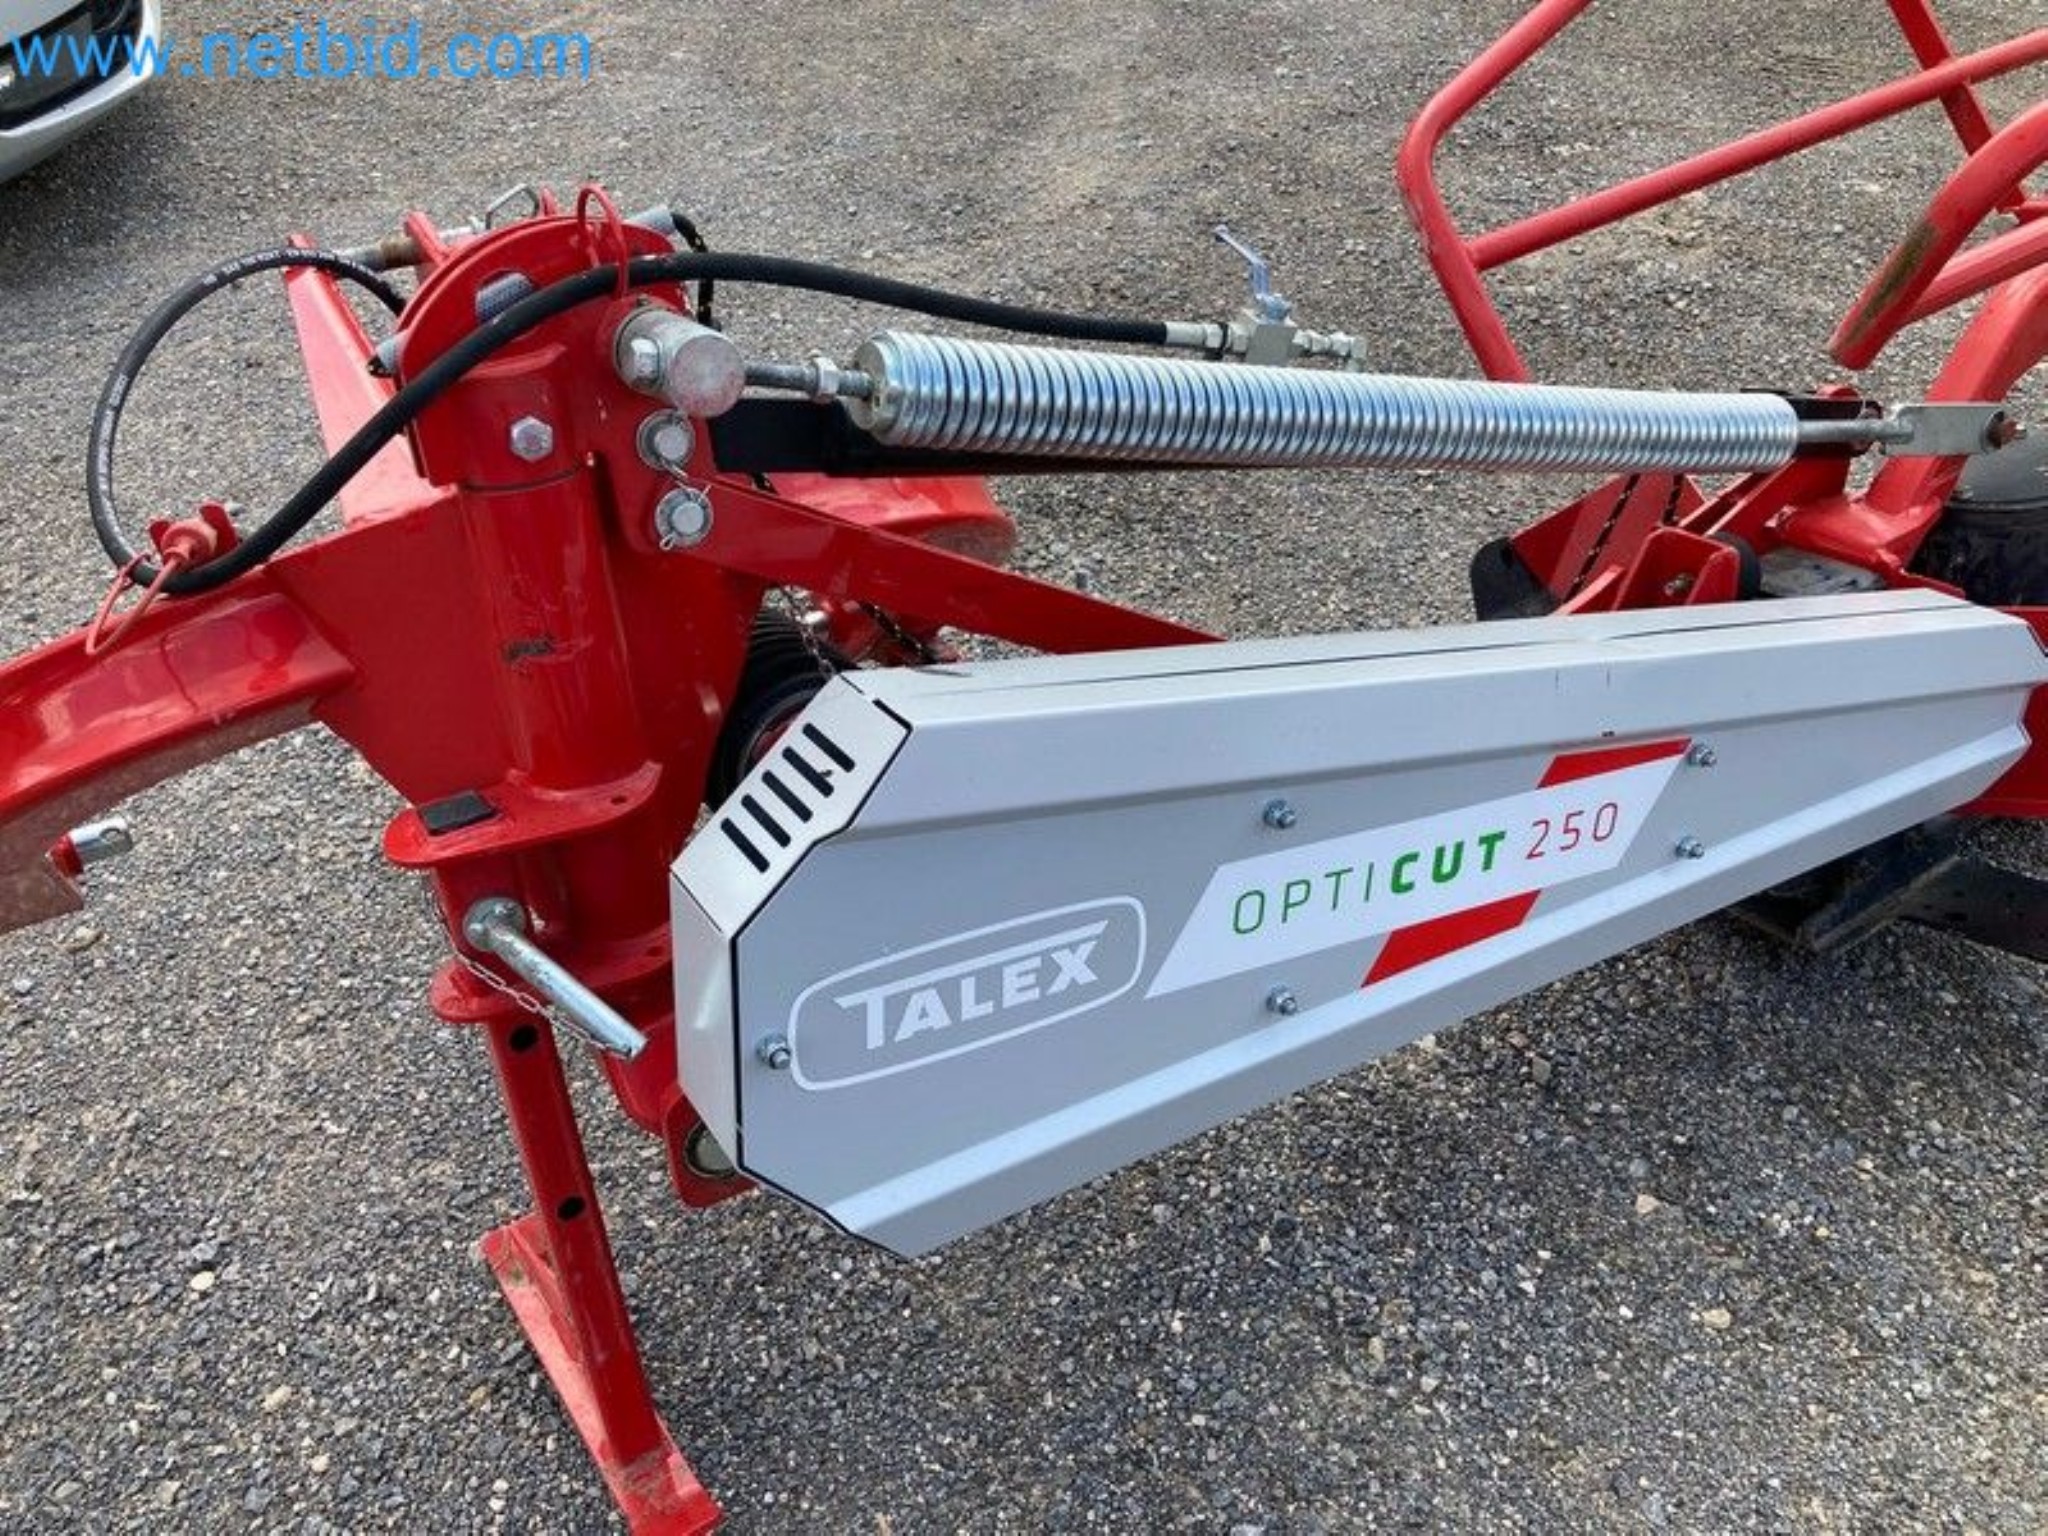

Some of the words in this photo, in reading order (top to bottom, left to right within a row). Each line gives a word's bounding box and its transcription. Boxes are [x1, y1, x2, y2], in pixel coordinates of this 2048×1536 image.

[1232, 831, 1507, 935] OPTICUT
[1526, 802, 1619, 860] 250
[834, 919, 1109, 1050] TALEX
